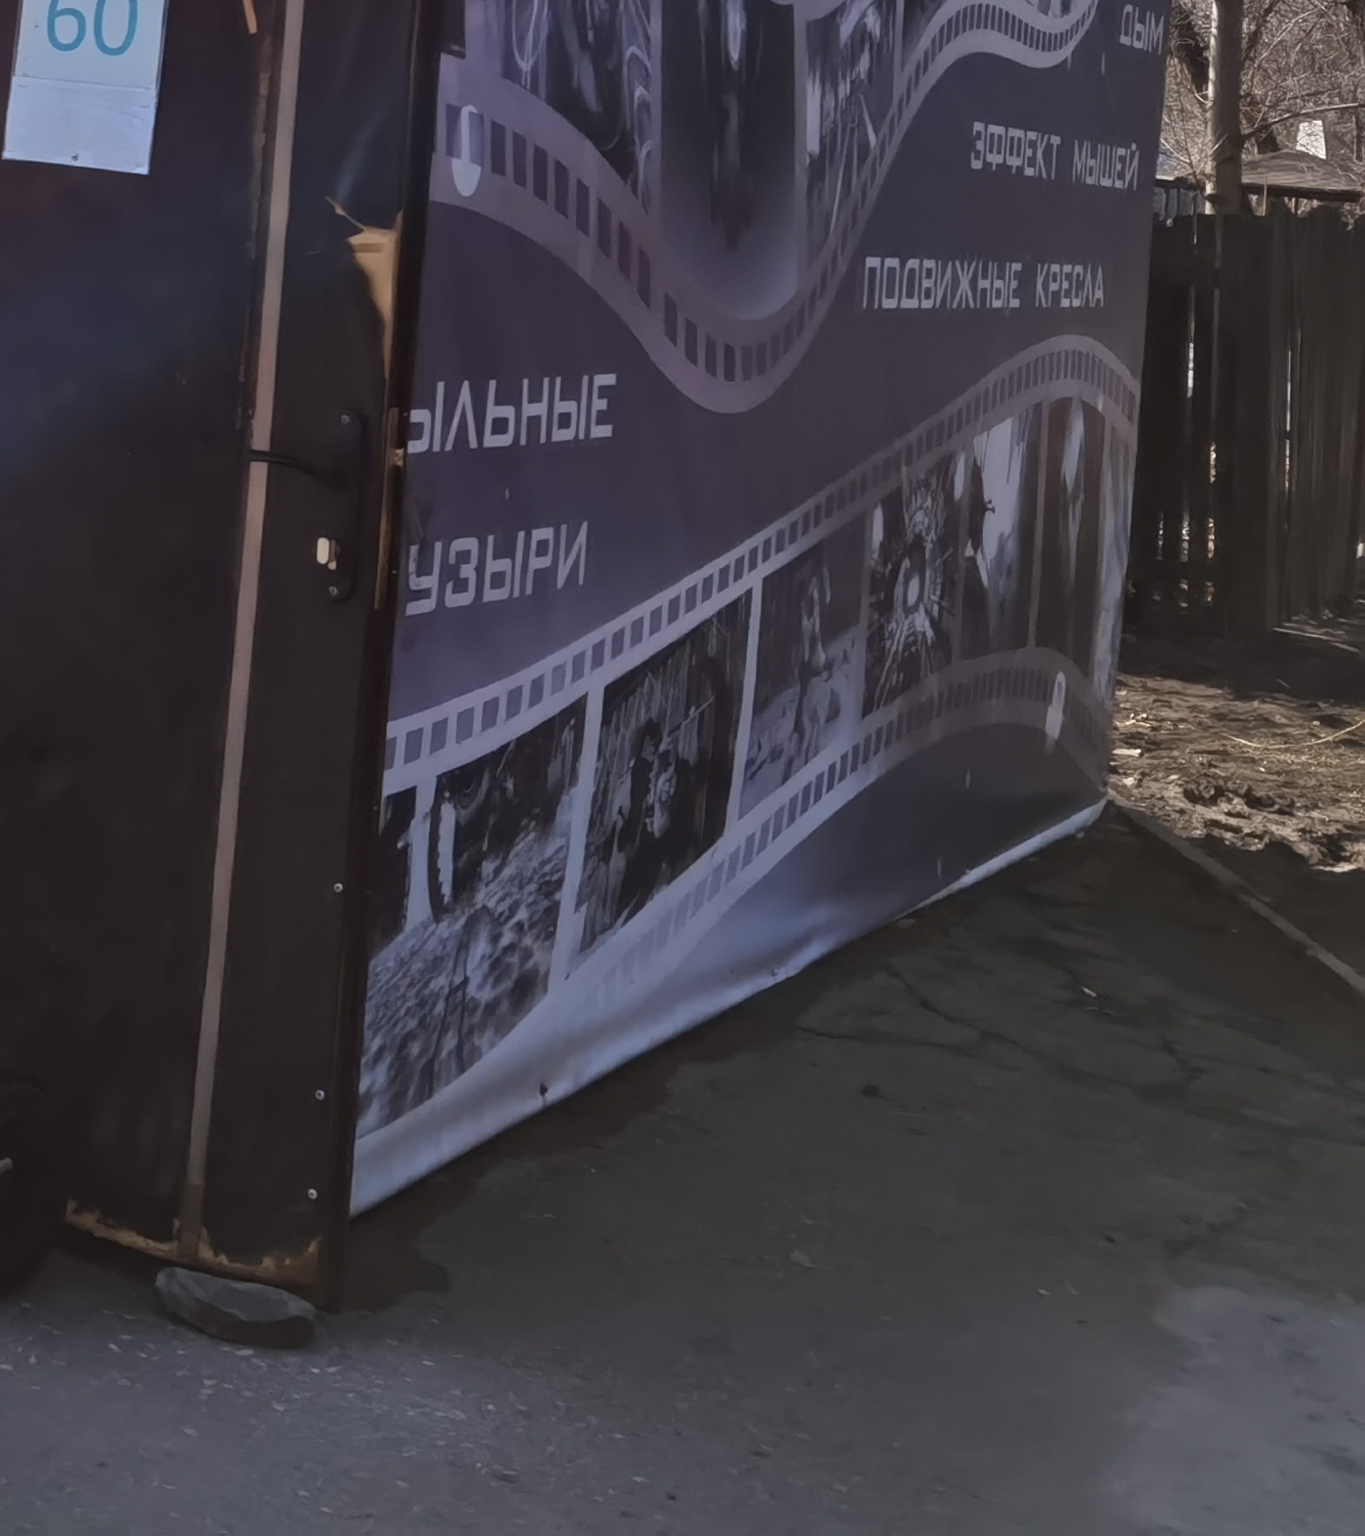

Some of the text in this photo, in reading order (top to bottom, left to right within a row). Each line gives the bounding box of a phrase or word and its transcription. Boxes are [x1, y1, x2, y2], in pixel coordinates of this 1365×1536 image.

[1118, 1, 1165, 56] ДЫМ
[969, 120, 1140, 192] ЭФФЕКТ МЫШЕЙ
[863, 256, 1106, 311] ПОДВИЖНЫЕ КРЕСЛА
[407, 373, 618, 456] ЫЛЬНЫЕ
[405, 520, 589, 618] УЗЫРИ
